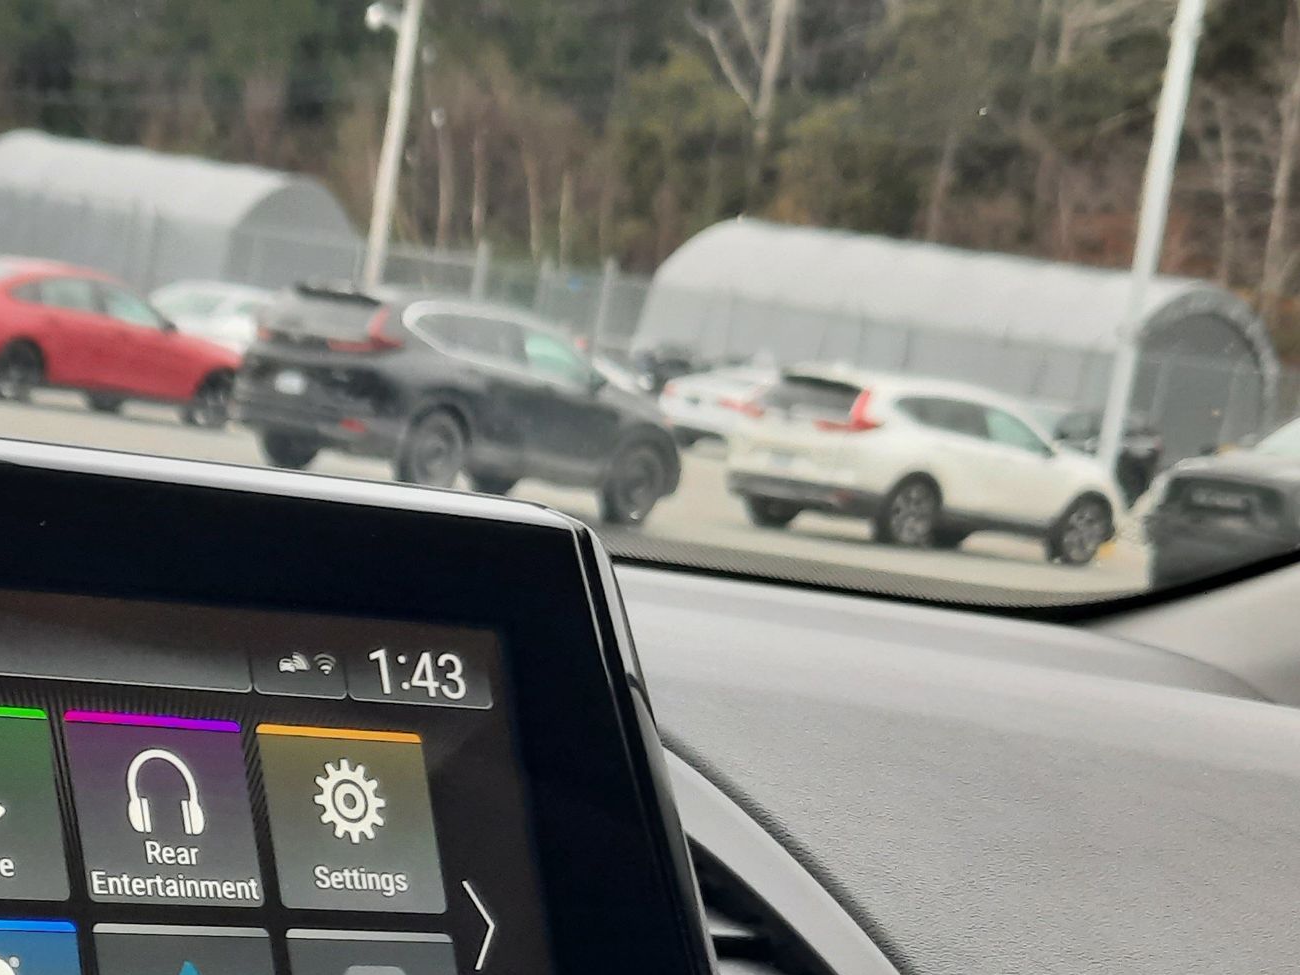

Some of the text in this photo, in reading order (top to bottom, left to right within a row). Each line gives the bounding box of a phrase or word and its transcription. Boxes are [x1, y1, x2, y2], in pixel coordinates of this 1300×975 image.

[368, 648, 467, 700] 1:43
[145, 840, 199, 865] Rear
[91, 871, 260, 900] Entertainment
[314, 865, 409, 896] Settings
